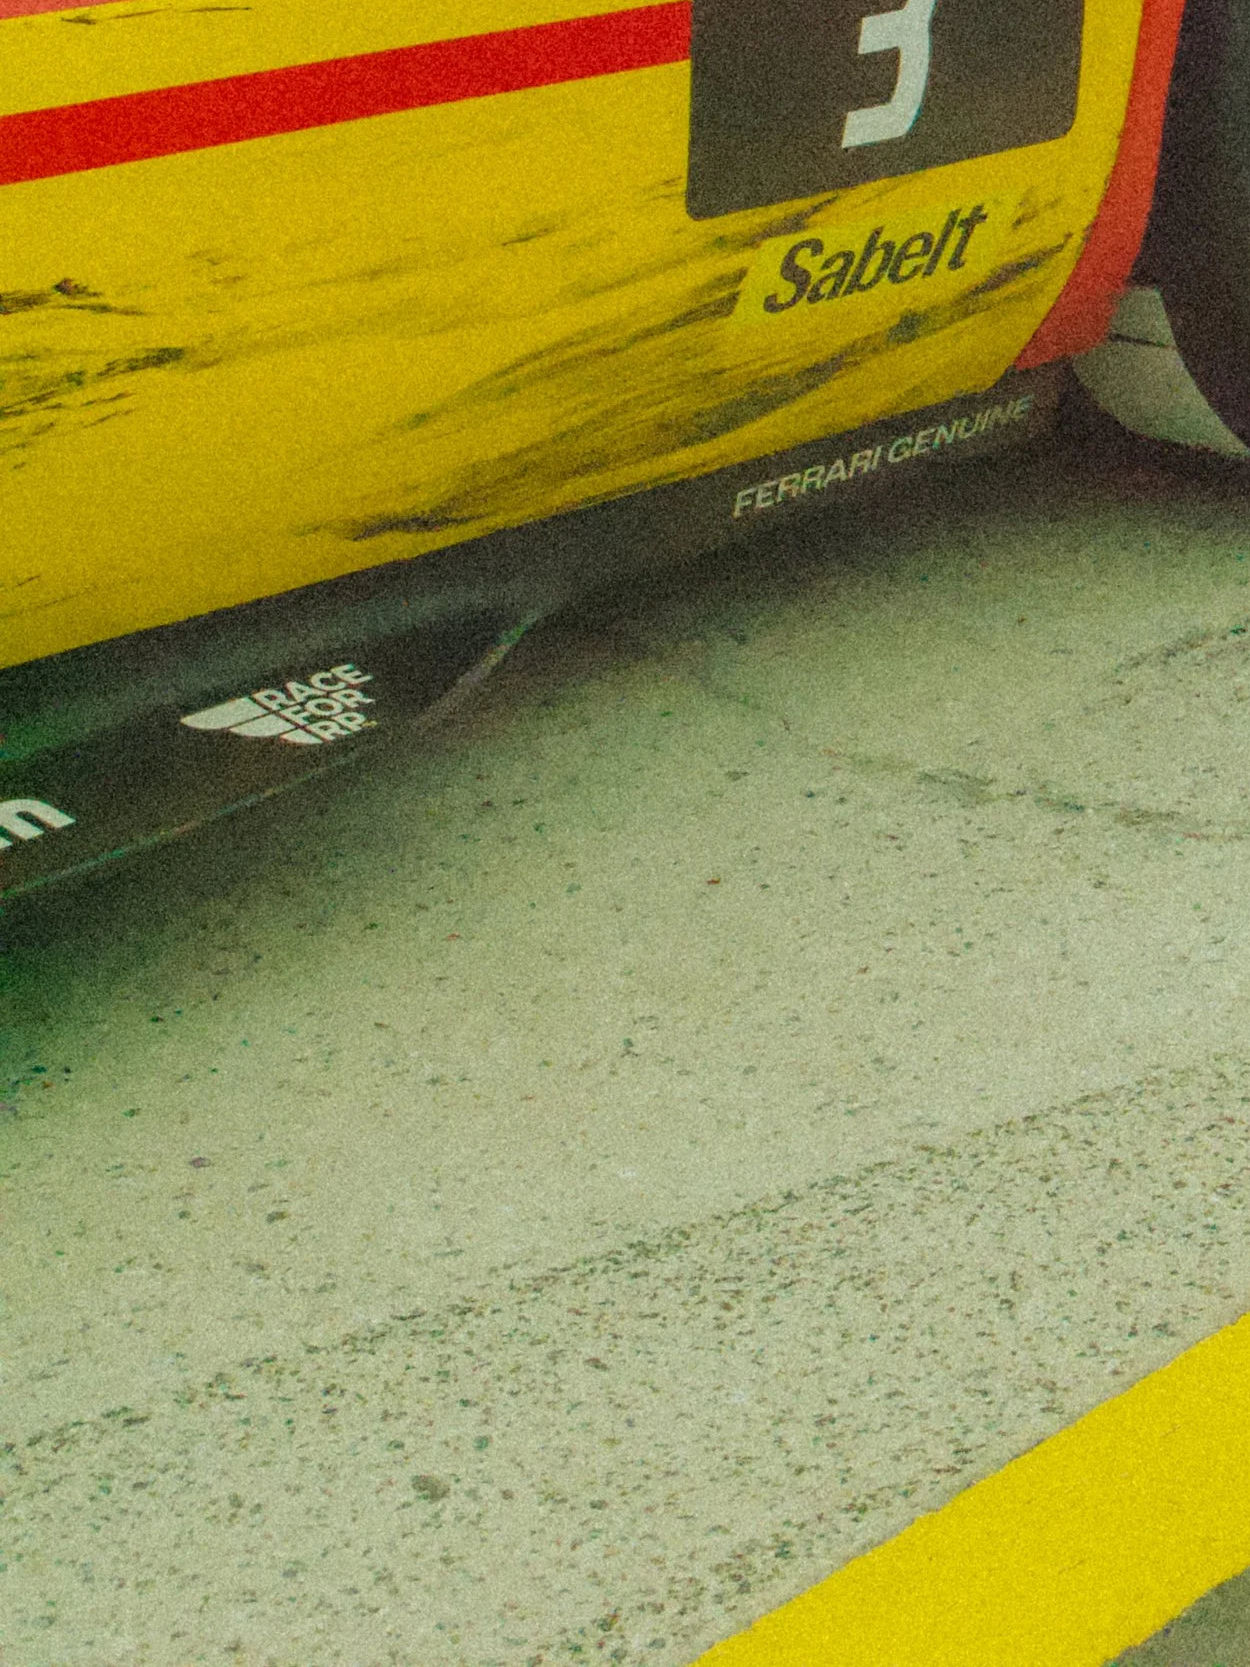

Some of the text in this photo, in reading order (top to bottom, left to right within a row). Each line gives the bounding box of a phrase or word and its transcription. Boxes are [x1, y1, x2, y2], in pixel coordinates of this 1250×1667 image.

[763, 205, 988, 314] Sabelt
[733, 393, 1036, 519] FERRARI GENUINE
[252, 663, 374, 710] RACE
[278, 688, 375, 726] FOR
